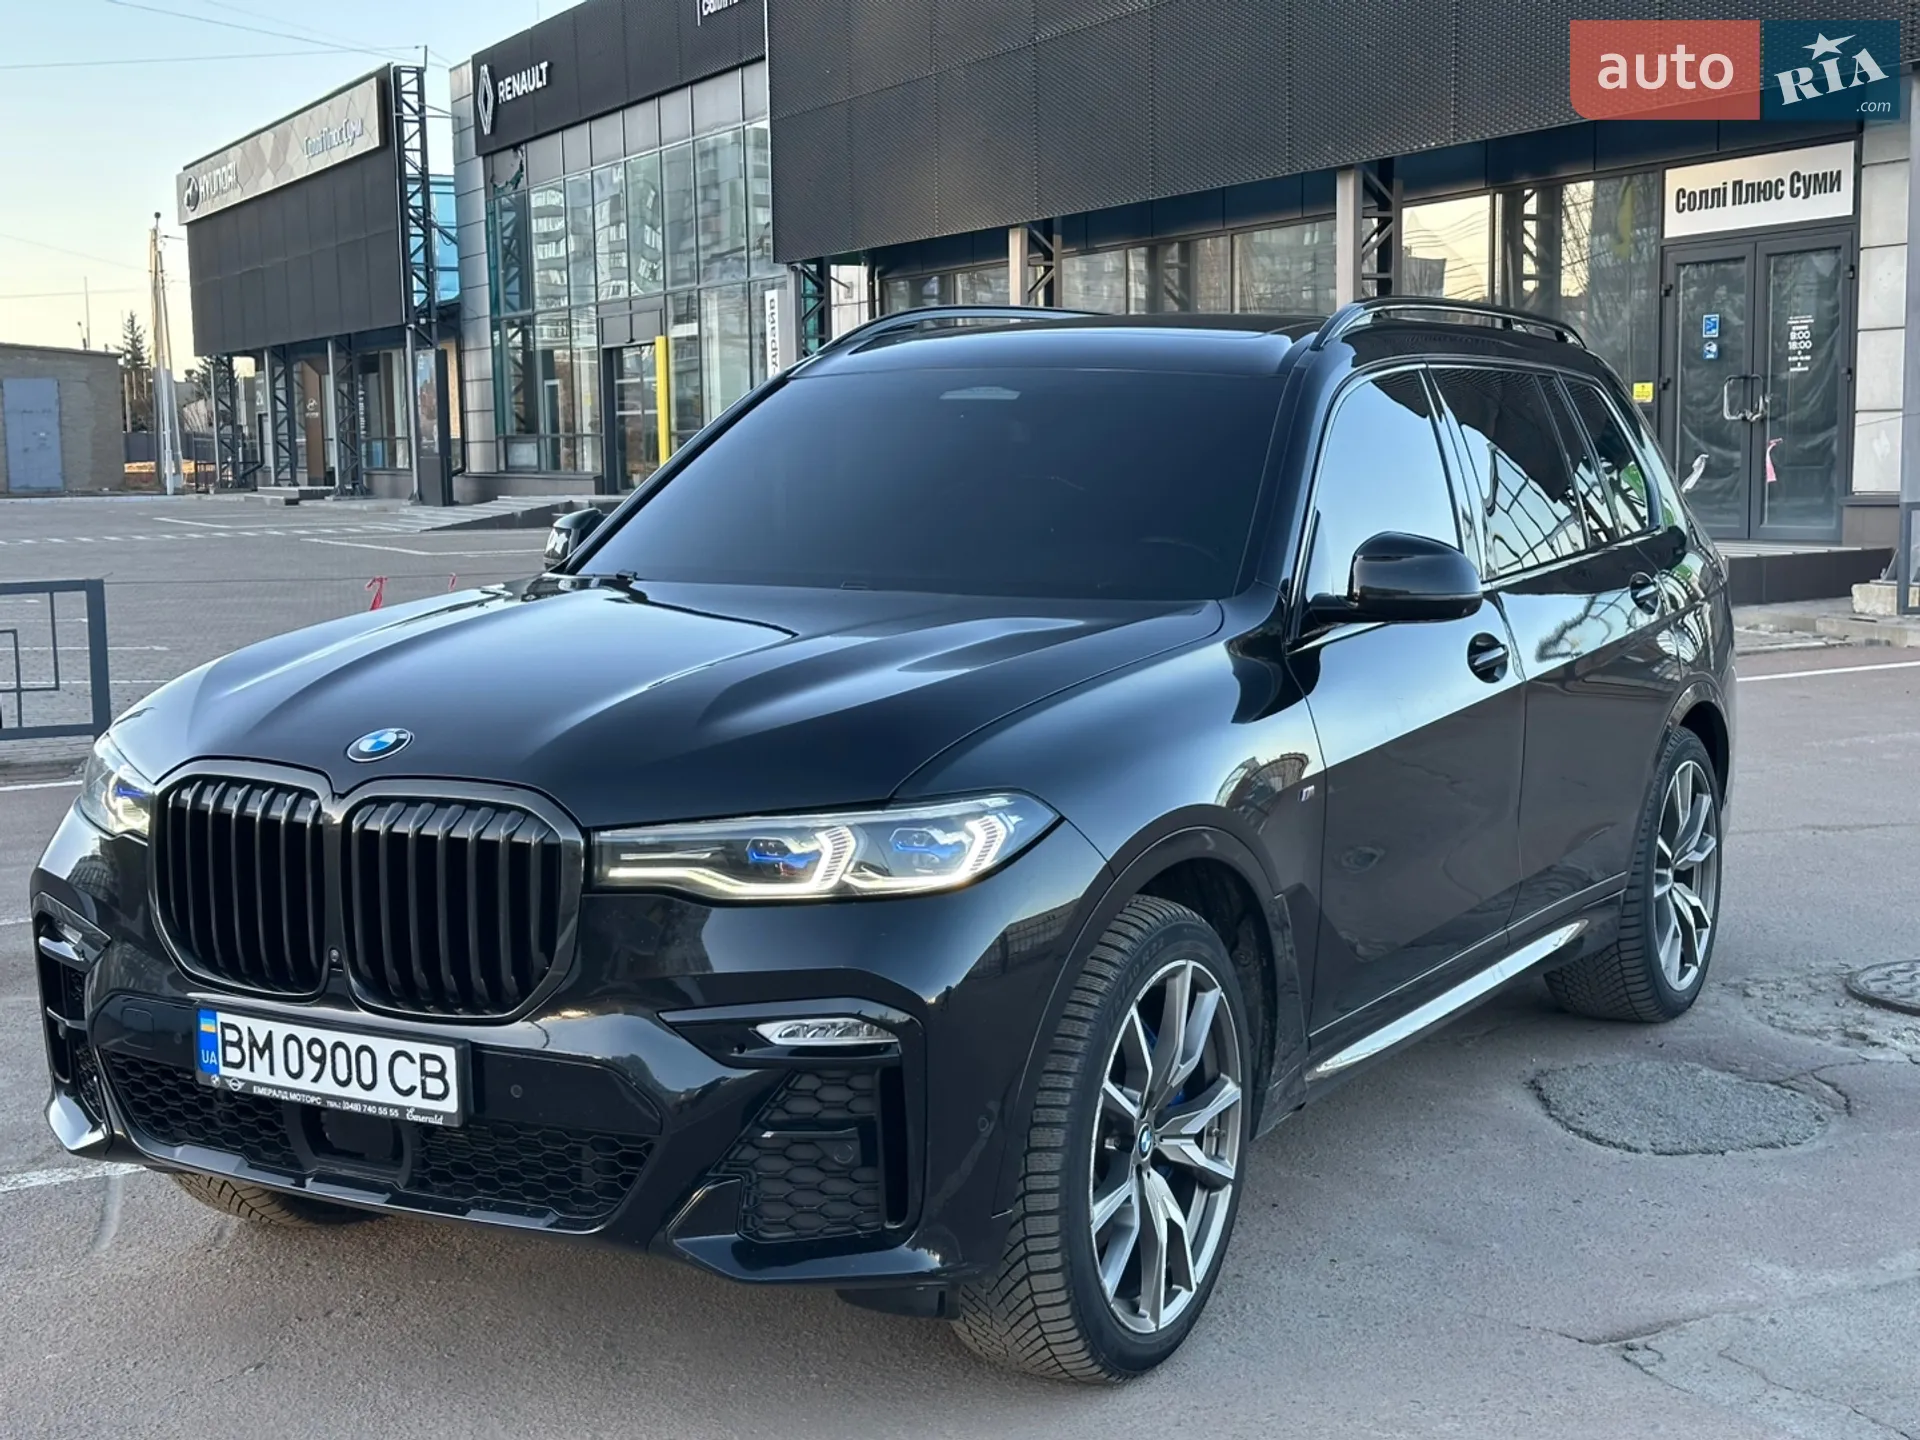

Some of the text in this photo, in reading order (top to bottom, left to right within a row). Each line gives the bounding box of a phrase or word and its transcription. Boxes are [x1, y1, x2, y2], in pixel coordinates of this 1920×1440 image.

[497, 61, 551, 104] RENAULT
[198, 161, 237, 203] HYUNDAI
[1675, 169, 1843, 214] Соллі Плюс Суми
[201, 1049, 218, 1065] UA
[219, 1021, 451, 1102] BM 0900 CB
[362, 1104, 377, 1114] 740
[389, 1108, 400, 1118] 55
[406, 1107, 444, 1125] Emerald
